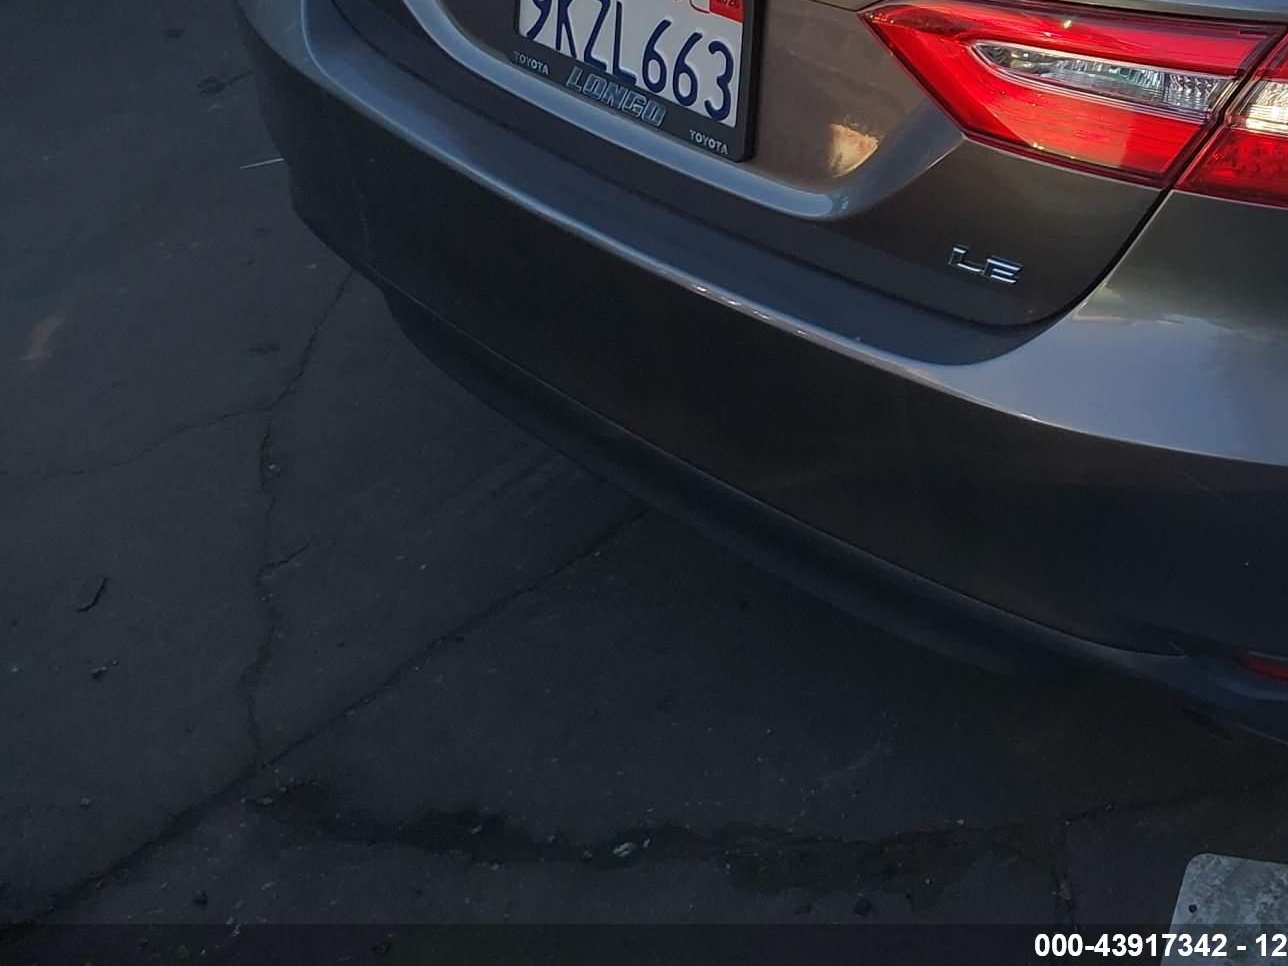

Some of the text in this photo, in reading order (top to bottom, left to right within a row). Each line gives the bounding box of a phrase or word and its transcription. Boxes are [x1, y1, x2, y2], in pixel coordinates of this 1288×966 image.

[513, 50, 549, 75] TOYOTA
[566, 65, 668, 128] LONGO
[689, 128, 729, 156] TOYOTA
[947, 243, 1023, 284] LE
